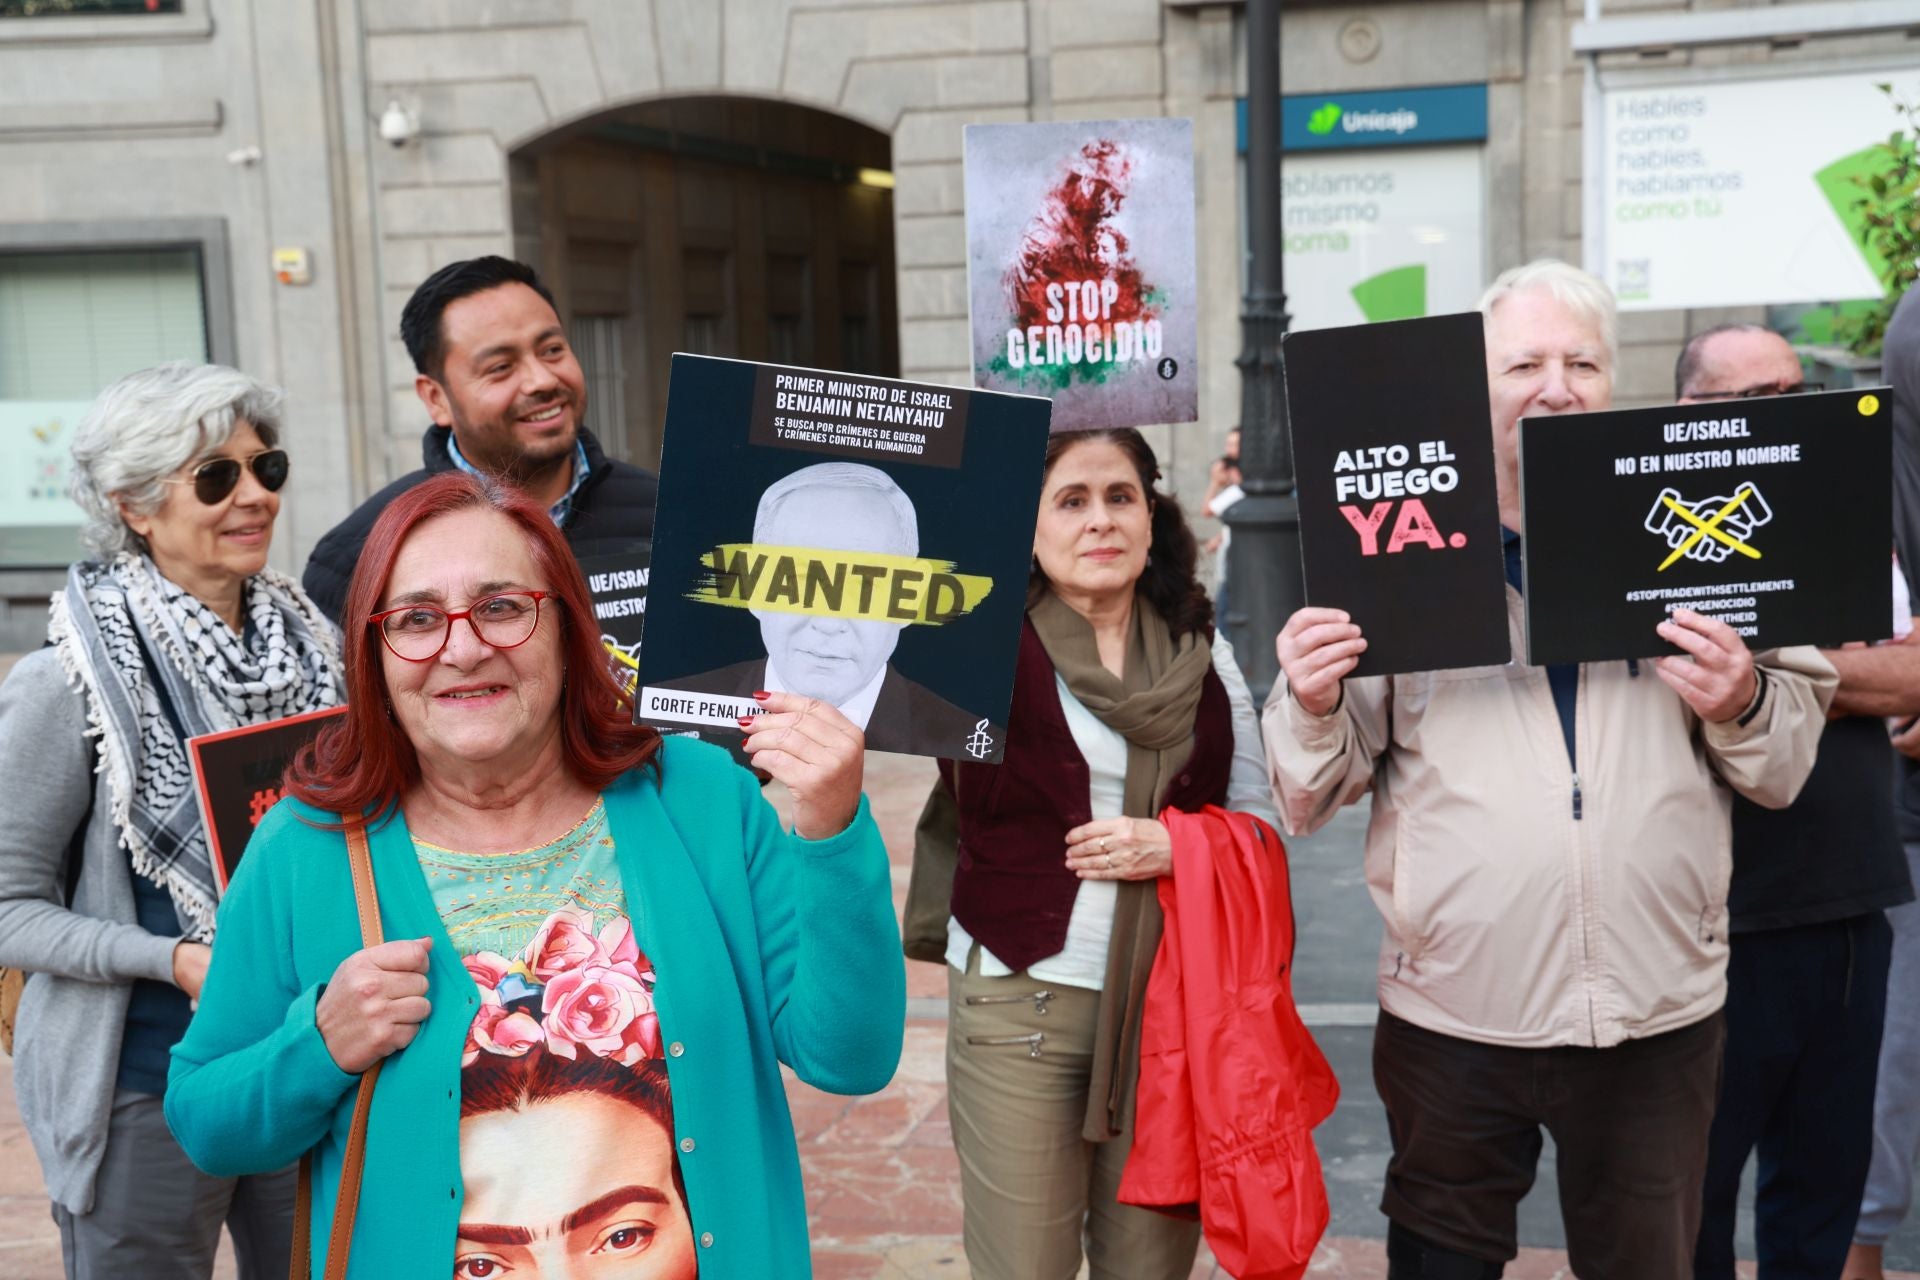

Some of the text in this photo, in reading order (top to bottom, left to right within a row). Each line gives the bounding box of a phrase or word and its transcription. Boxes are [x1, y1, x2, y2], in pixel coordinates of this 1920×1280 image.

[1616, 95, 1706, 119] Hables
[1342, 107, 1418, 135] Unicaja
[1616, 124, 1690, 146] como
[1616, 171, 1744, 197] hablamos
[1616, 201, 1690, 222] como
[1046, 279, 1119, 323] STOP
[1007, 319, 1163, 368] GENOCIDIO
[775, 374, 952, 410] PRIMER MINISTRO DE ISRAEL
[776, 392, 945, 429] BENJAMIN NETANYAHU
[774, 417, 926, 444] SE BUSCA POR CRÍMENES DE GUERRA
[777, 428, 924, 455] Y CRÍMENES CONTRA LA HUMANIDAD
[1663, 417, 1751, 443] UE/ISRAEL
[1333, 440, 1456, 473] ALTO EL
[1615, 444, 1801, 475] NO EN NUESTRO NOMBRE
[1335, 465, 1459, 503] FUEGO
[1338, 498, 1467, 556] YA.
[711, 546, 966, 623] WANTED
[1626, 579, 1795, 602] #STOPTRADEWITHSETTLEMENTS
[1664, 597, 1757, 613] #STOPGENOCIDIO
[651, 696, 695, 715] CORTE
[698, 701, 740, 720] PENAL
